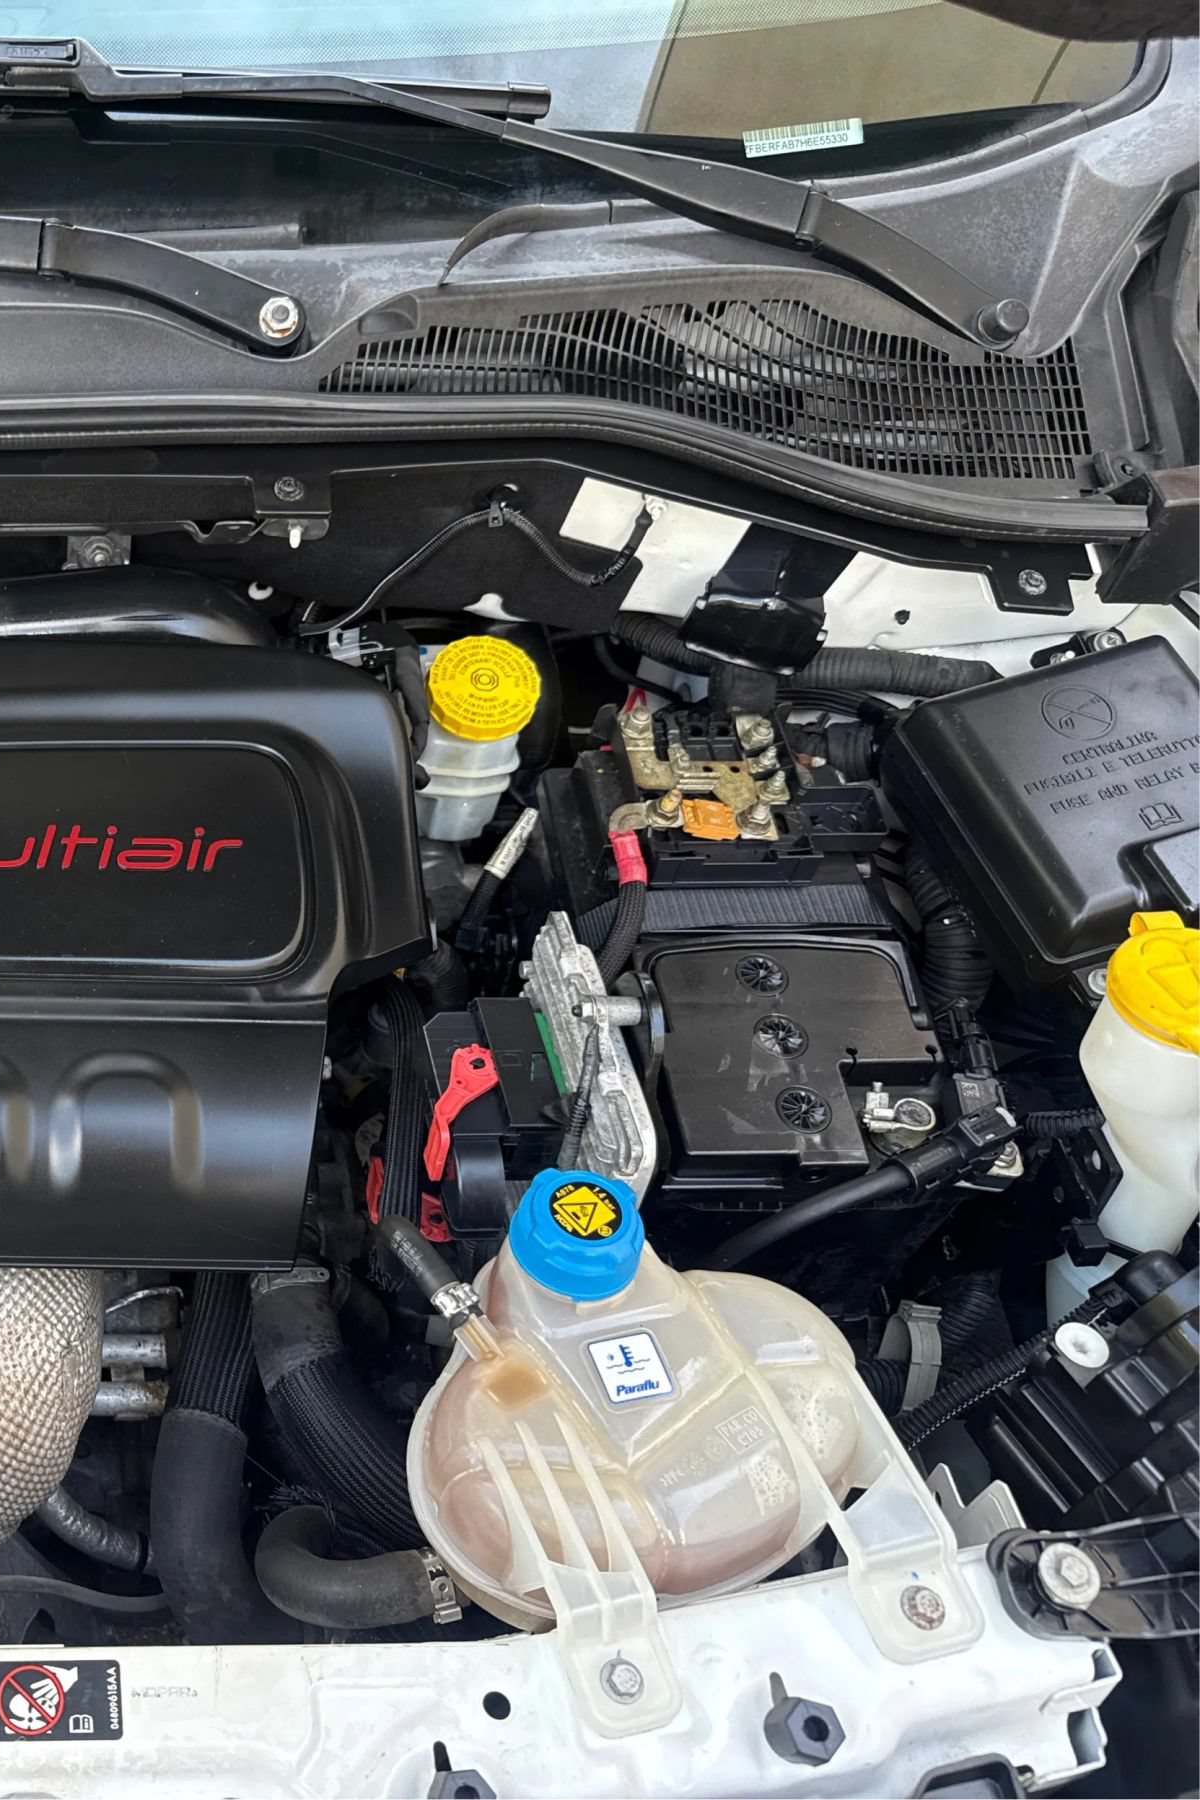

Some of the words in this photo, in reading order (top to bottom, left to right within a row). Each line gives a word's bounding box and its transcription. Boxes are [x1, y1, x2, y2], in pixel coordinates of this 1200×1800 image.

[1062, 730, 1158, 765] CENTRALINA
[1023, 766, 1098, 796] FUSIBILI
[1102, 760, 1118, 773] E
[1050, 794, 1094, 814] FUSE
[1097, 783, 1130, 801] AND
[1134, 766, 1185, 790] RELAY
[616, 1379, 660, 1397] Paraflu
[106, 1666, 120, 1730] 04809615AA
